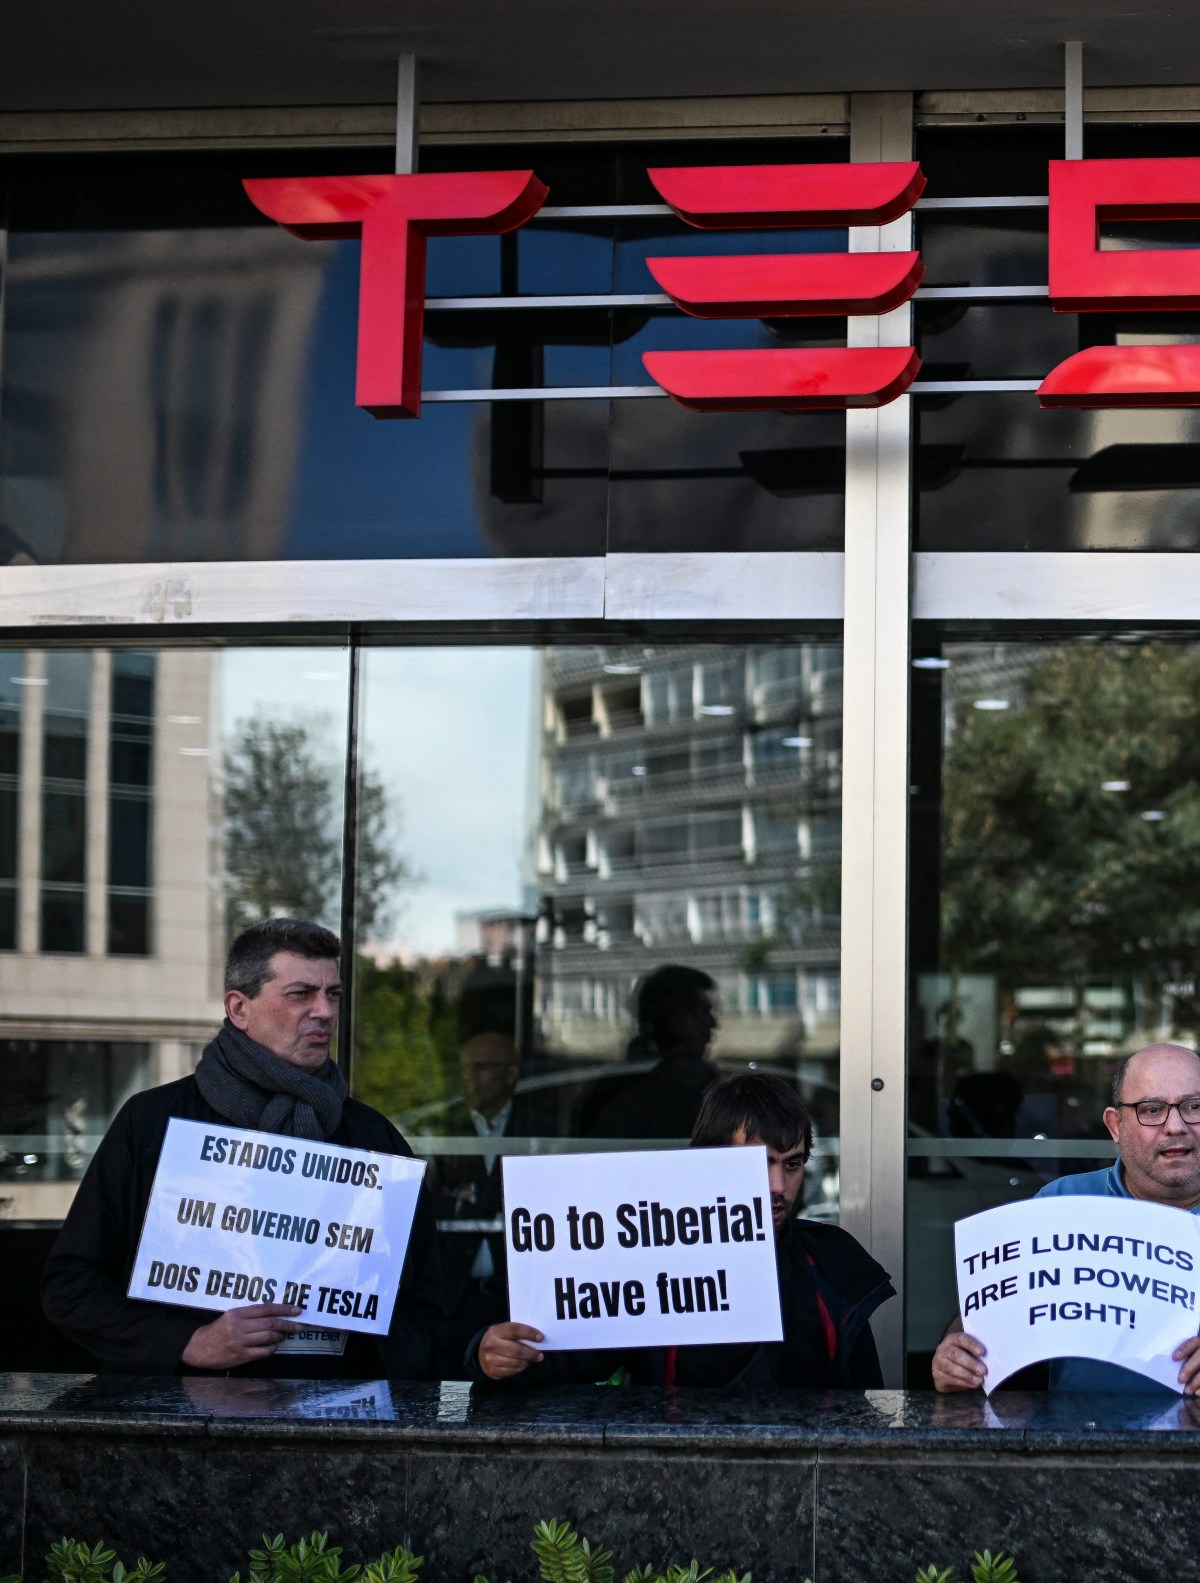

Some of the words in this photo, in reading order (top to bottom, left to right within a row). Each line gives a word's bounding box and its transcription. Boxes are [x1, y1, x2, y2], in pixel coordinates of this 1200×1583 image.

[200, 1135, 297, 1175] ESTADOS
[301, 1152, 383, 1190] UNIDOS.
[176, 1197, 216, 1229] UM
[221, 1205, 321, 1245] GOVERNO
[325, 1222, 374, 1254] SEM
[511, 1207, 556, 1253] Go
[567, 1206, 605, 1251] to
[616, 1196, 766, 1249] Siberia!
[963, 1240, 1021, 1275] THE
[1031, 1233, 1194, 1272] LUNATICS
[147, 1260, 200, 1293] DOIS
[205, 1269, 277, 1305] DEDOS
[284, 1281, 311, 1310] DE
[315, 1287, 379, 1321] TESLA
[554, 1277, 646, 1320] Have
[656, 1269, 730, 1315] fun!
[964, 1275, 1018, 1318] ARE
[1029, 1268, 1061, 1290] IN
[1073, 1267, 1196, 1312] POWER!
[1029, 1301, 1136, 1330] FIGHT!
